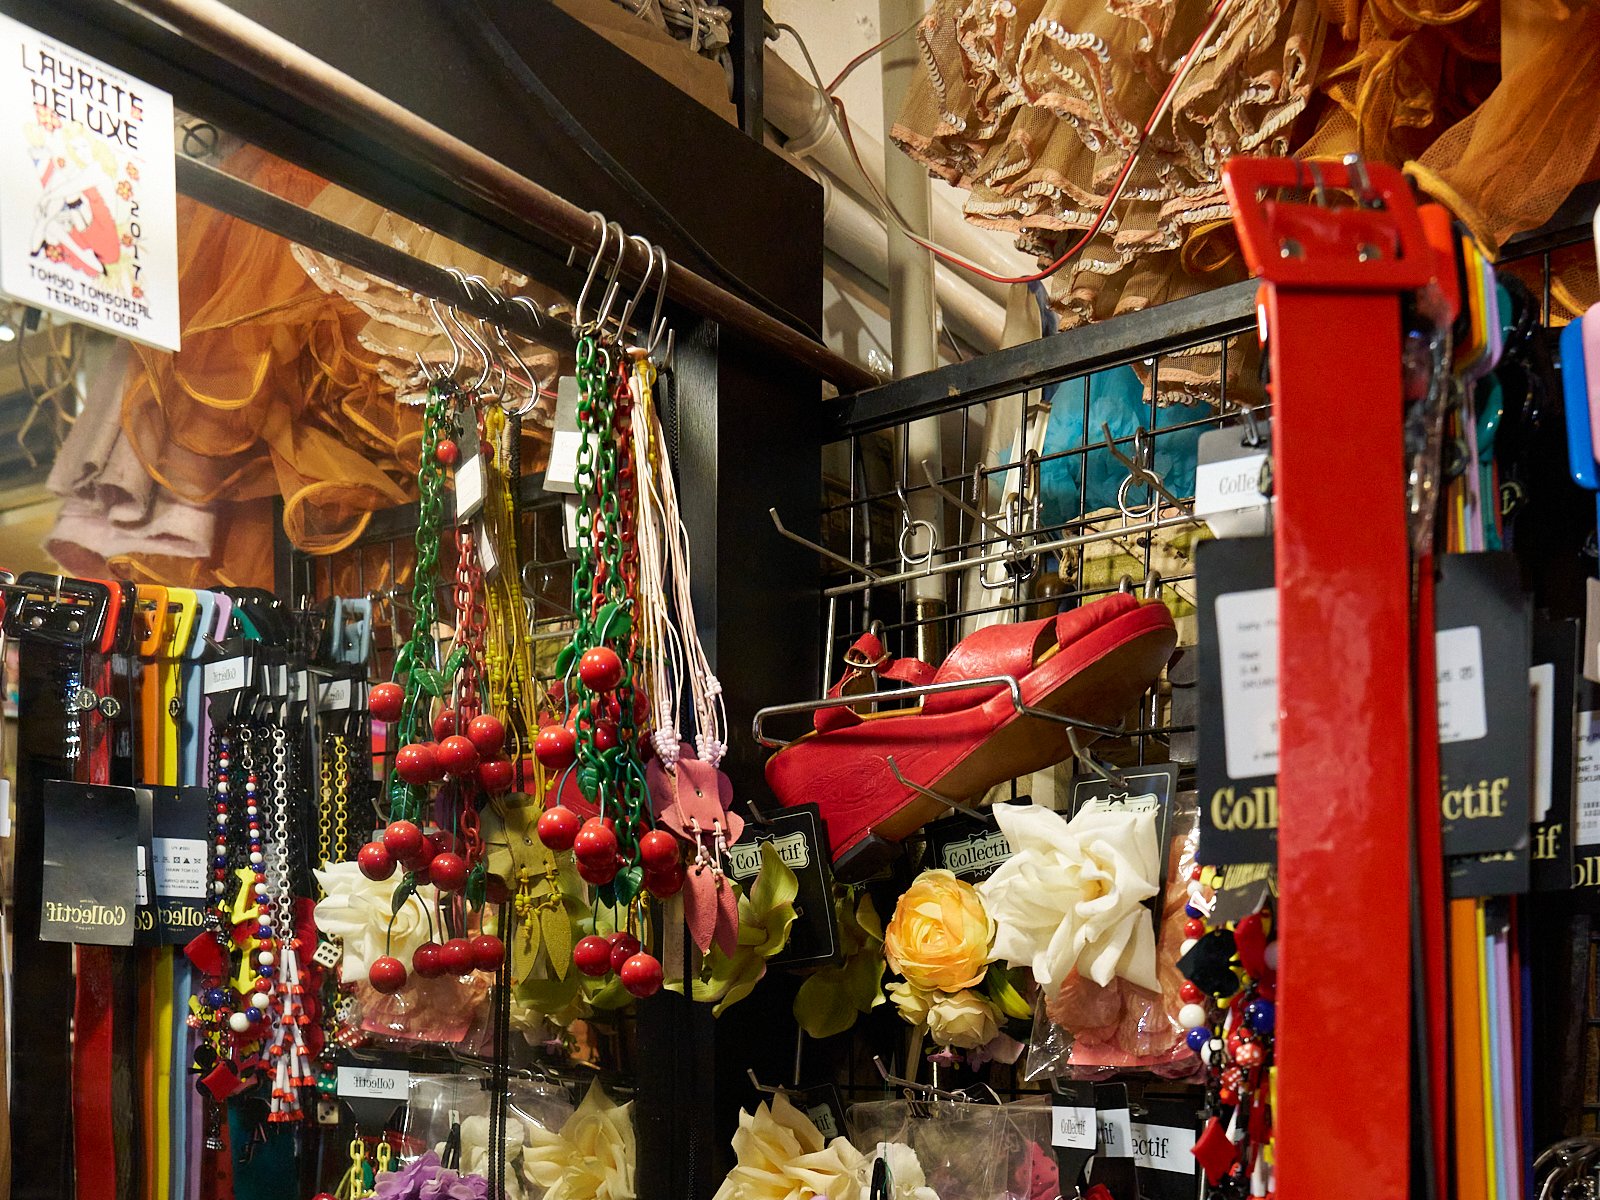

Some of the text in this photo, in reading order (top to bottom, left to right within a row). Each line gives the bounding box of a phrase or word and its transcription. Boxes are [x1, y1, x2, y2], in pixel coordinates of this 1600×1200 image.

[22, 44, 144, 122] LAYRITE
[31, 78, 138, 150] DELUXE
[46, 286, 139, 330] TERROR TOUR
[1060, 1118, 1086, 1136] Collectif
